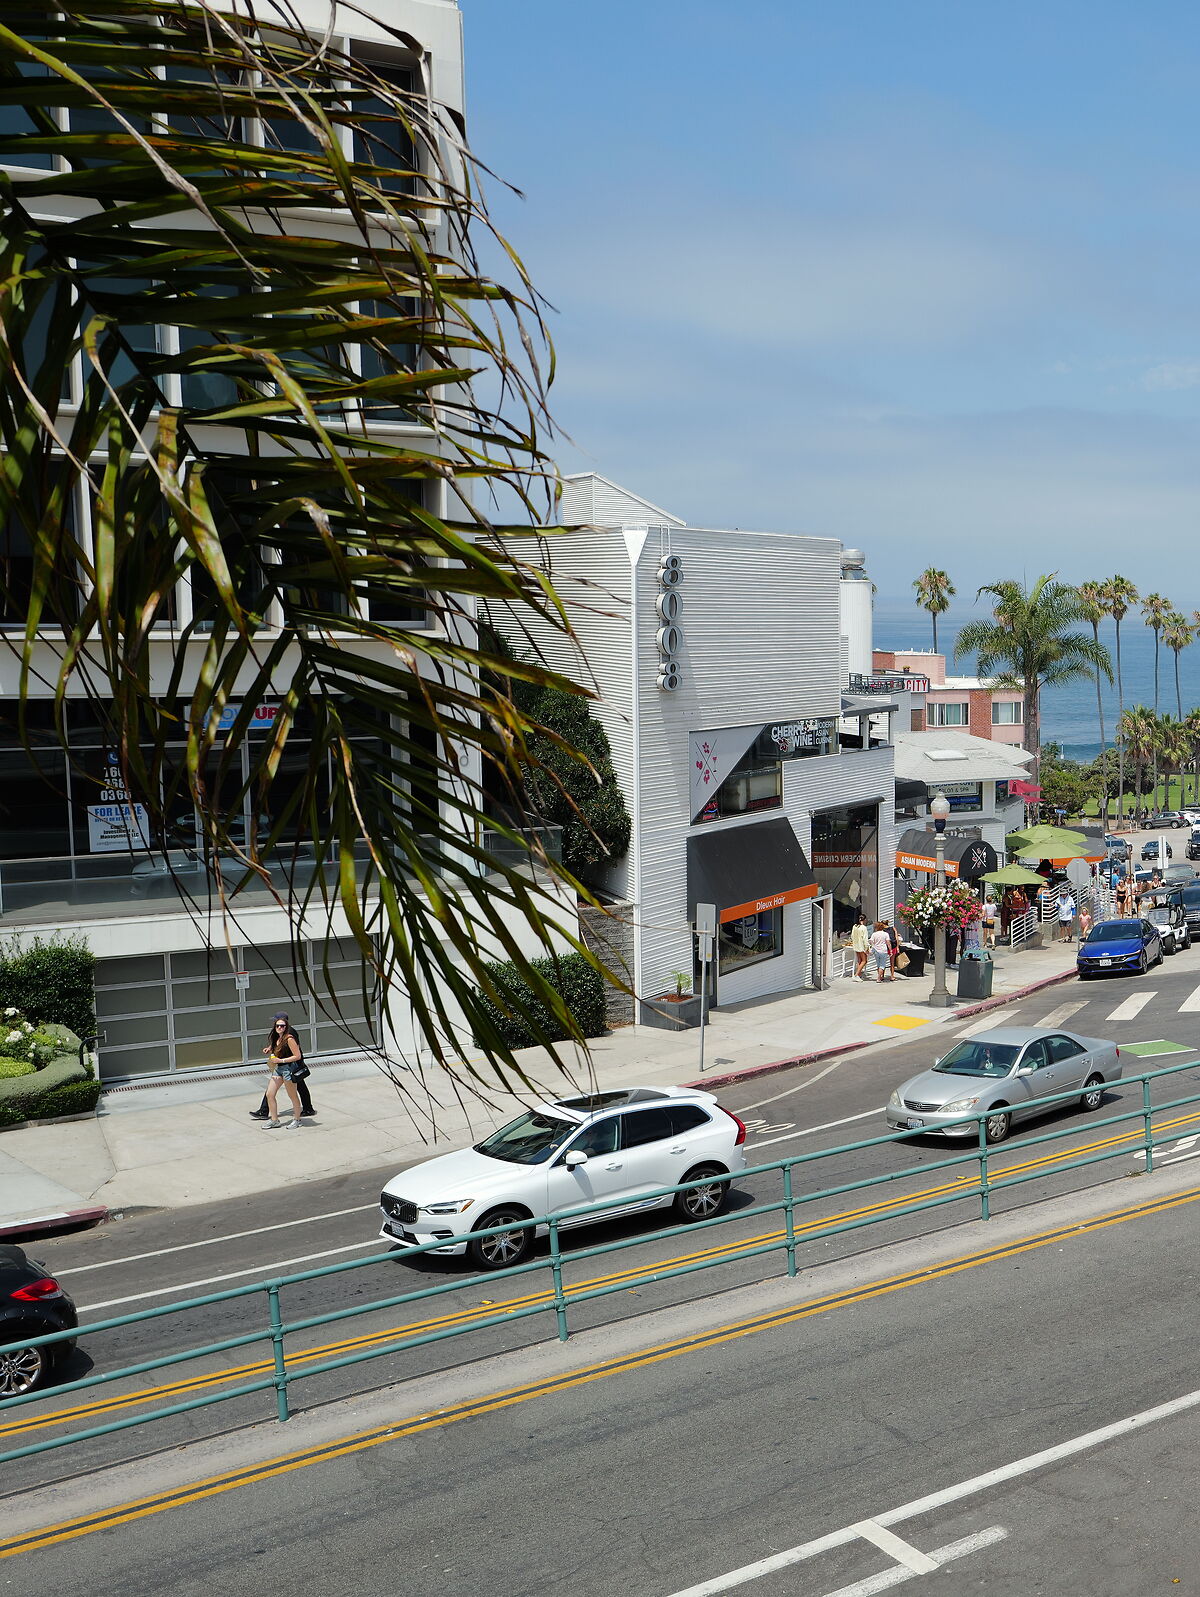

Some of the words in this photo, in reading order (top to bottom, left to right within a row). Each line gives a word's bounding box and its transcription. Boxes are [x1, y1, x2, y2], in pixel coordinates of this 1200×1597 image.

[906, 680, 928, 691] CITY
[792, 734, 813, 747] WINE
[94, 808, 112, 817] FOR
[115, 805, 142, 816] LEAE
[901, 856, 916, 866] ASIAN
[915, 858, 936, 869] MODERN
[773, 895, 786, 906] Hair
